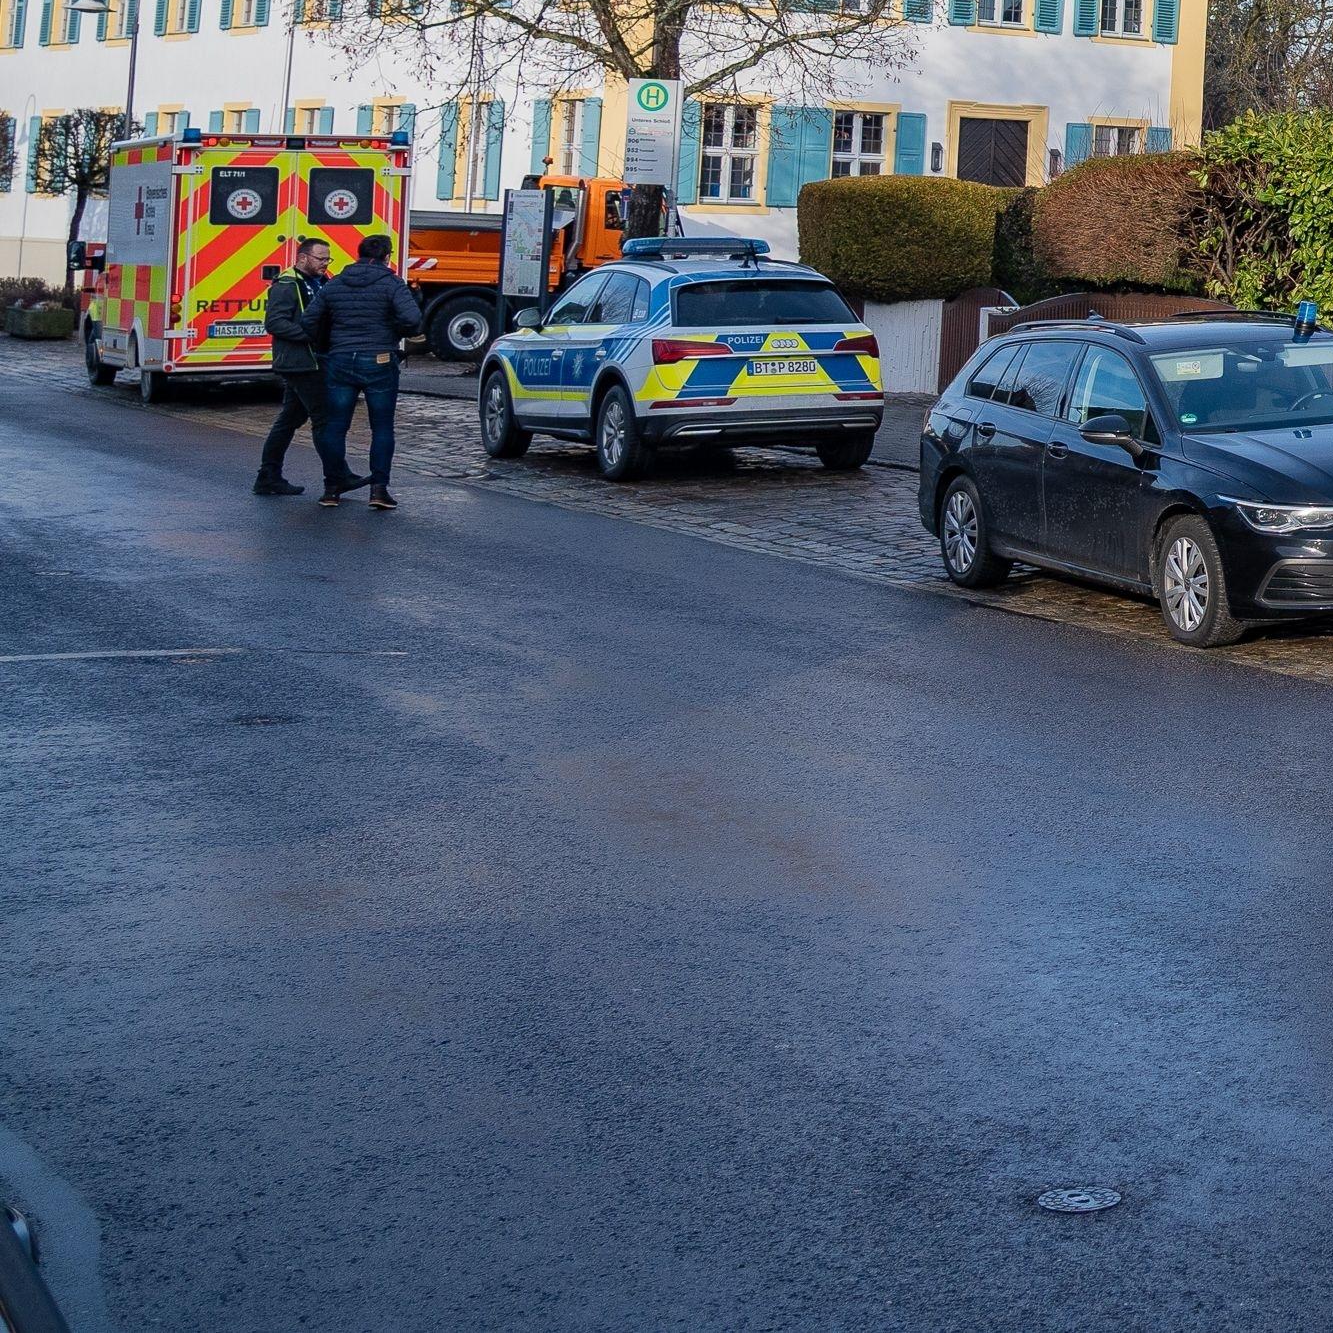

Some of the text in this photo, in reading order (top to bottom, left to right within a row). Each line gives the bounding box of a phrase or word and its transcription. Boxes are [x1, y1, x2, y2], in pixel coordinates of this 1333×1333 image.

[646, 89, 659, 105] H
[196, 299, 267, 312] RETTU
[215, 326, 232, 336] HAS
[727, 336, 764, 344] POLIZEI
[523, 358, 551, 376] POLIZEI
[754, 361, 816, 374] BT P 8280
